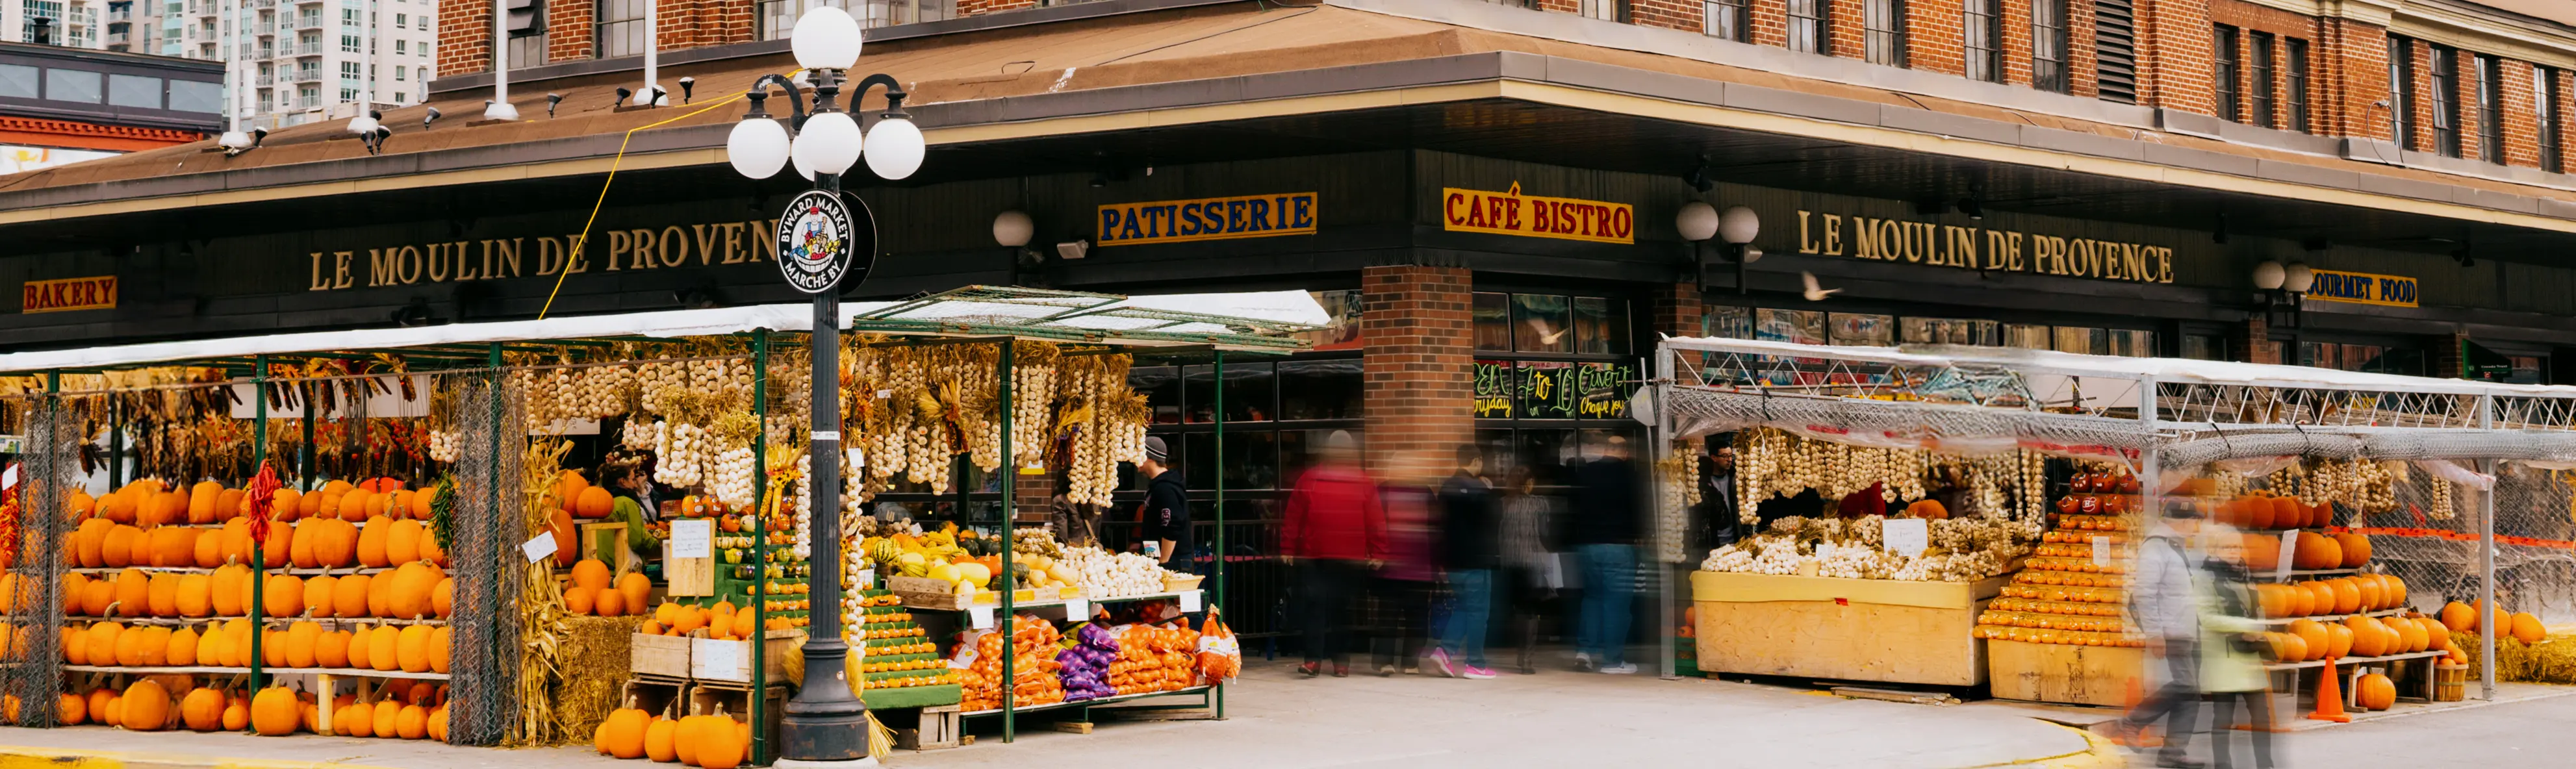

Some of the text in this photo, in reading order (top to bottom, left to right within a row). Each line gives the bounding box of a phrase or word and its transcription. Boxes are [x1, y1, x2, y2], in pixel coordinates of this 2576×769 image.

[781, 197, 848, 242] BYWARD MARKET
[1101, 196, 1313, 241] PATISSERIE
[1446, 186, 1631, 238] CAFÉ BISTRO
[309, 218, 780, 291] LE MOULIN DE PROVEN
[1797, 210, 2174, 283] LE MOULIN DE PROVENCE
[23, 279, 114, 310] BAKERY
[785, 260, 841, 288] MARCHÉ BY
[2380, 278, 2416, 303] FOOD
[1473, 362, 1509, 395] PEN
[1534, 372, 1554, 399] to
[1549, 368, 1574, 411] 10
[1473, 392, 1512, 418] ryday
[1581, 397, 1625, 418] Chaque jou
